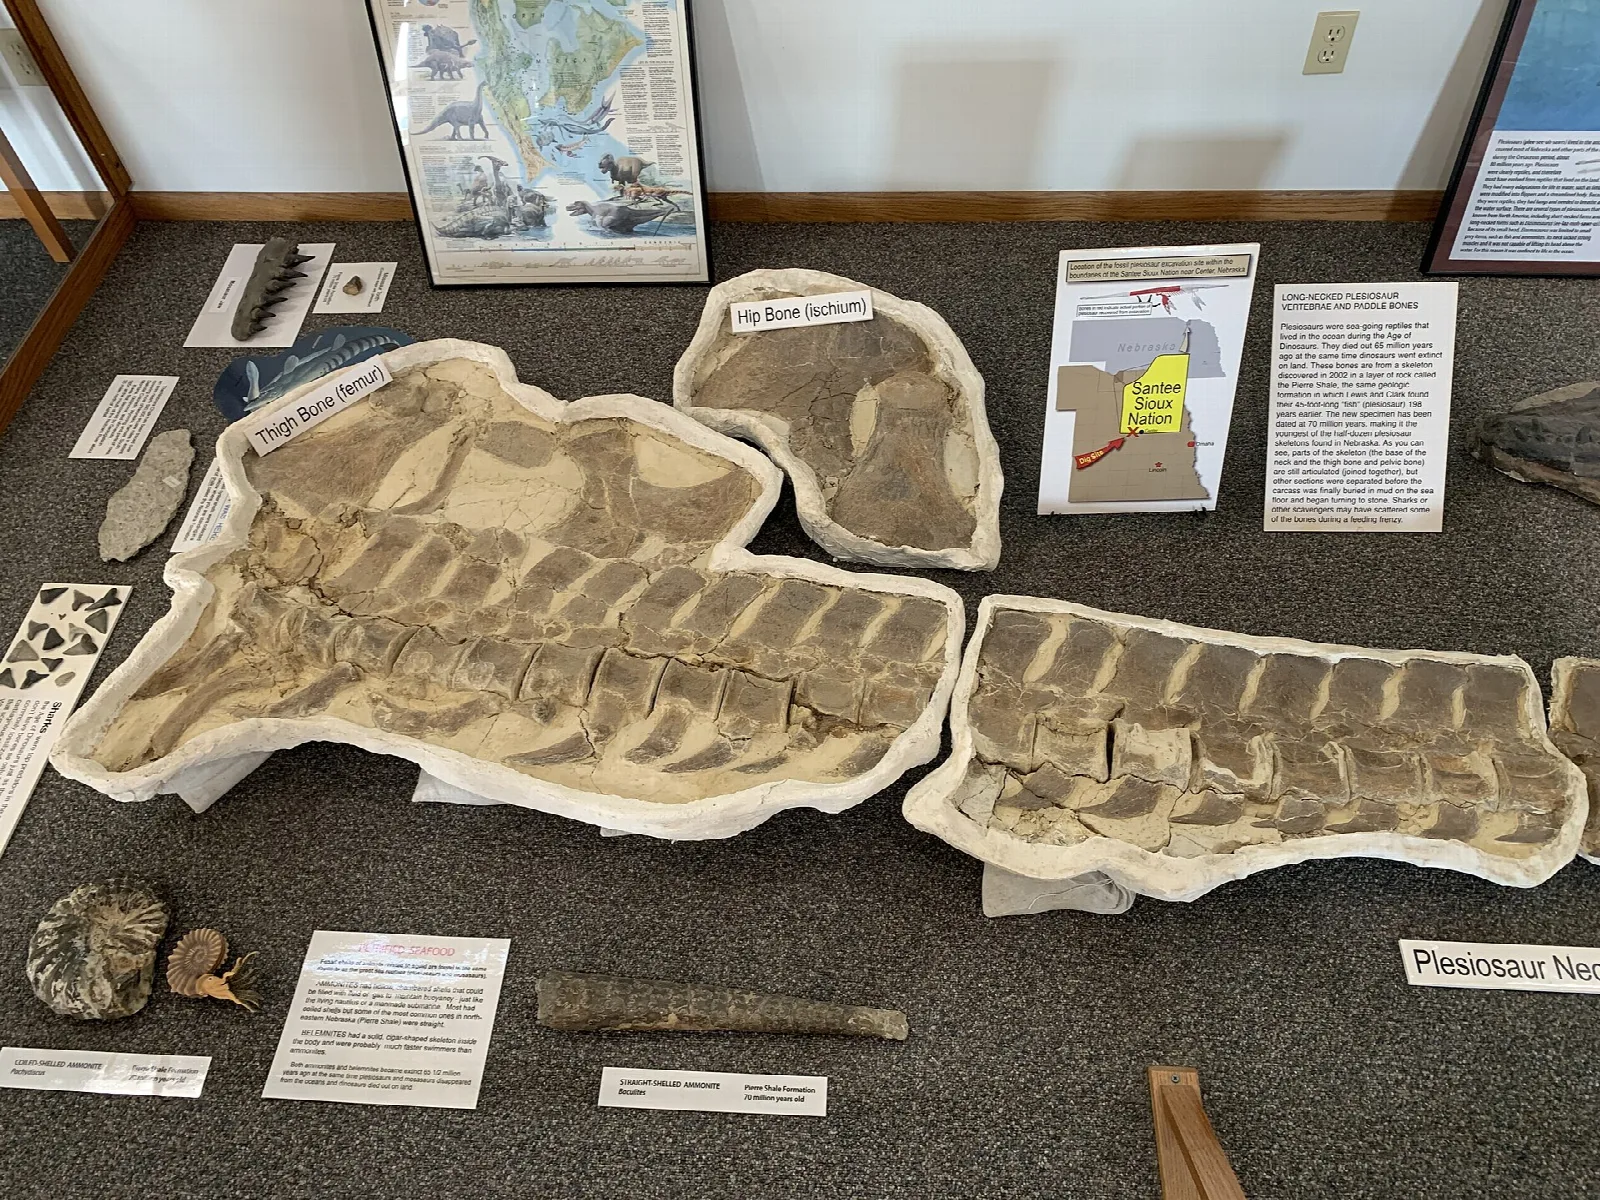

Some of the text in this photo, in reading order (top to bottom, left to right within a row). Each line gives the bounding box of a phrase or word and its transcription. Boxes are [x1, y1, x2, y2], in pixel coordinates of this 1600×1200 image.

[1069, 263, 1095, 271] Location
[1205, 258, 1223, 266] within
[1160, 268, 1180, 276] Nation
[1282, 292, 1400, 301] LONG-NECKED PLESIOSAUR
[1281, 303, 1332, 311] VERTEBRAE
[1353, 302, 1387, 310] PADDLE
[1388, 302, 1419, 310] BONES
[738, 298, 866, 326] Hip Bone (ischium)
[1384, 322, 1413, 331] reptiles
[1347, 332, 1372, 341] during
[1118, 343, 1176, 352] Nebraska
[1320, 342, 1341, 351] They
[1365, 371, 1385, 380] layer
[1132, 382, 1181, 395] Santee
[255, 365, 384, 444] Thigh Bone (femur)
[1135, 397, 1173, 410] Sioux
[1128, 412, 1172, 425] Nation
[1079, 450, 1104, 465] Dig Site
[39, 702, 62, 734] Sharks
[1413, 949, 1545, 980] Plesiosaur
[355, 1016, 380, 1026] (Pierre
[384, 1033, 429, 1044] cigar-shaped
[428, 1036, 457, 1044] skeleton
[303, 1038, 322, 1048] body
[351, 1041, 382, 1051] probably
[383, 1042, 403, 1050] much
[403, 1043, 423, 1051] faster
[423, 1044, 457, 1053] swimmers
[14, 1059, 65, 1068] COILED-SHELLED
[619, 1078, 721, 1090] STRAIGHT-SHELLED AMMONITE
[783, 1085, 816, 1093] Formation
[618, 1088, 647, 1096] Baculites
[776, 1096, 793, 1104] years
